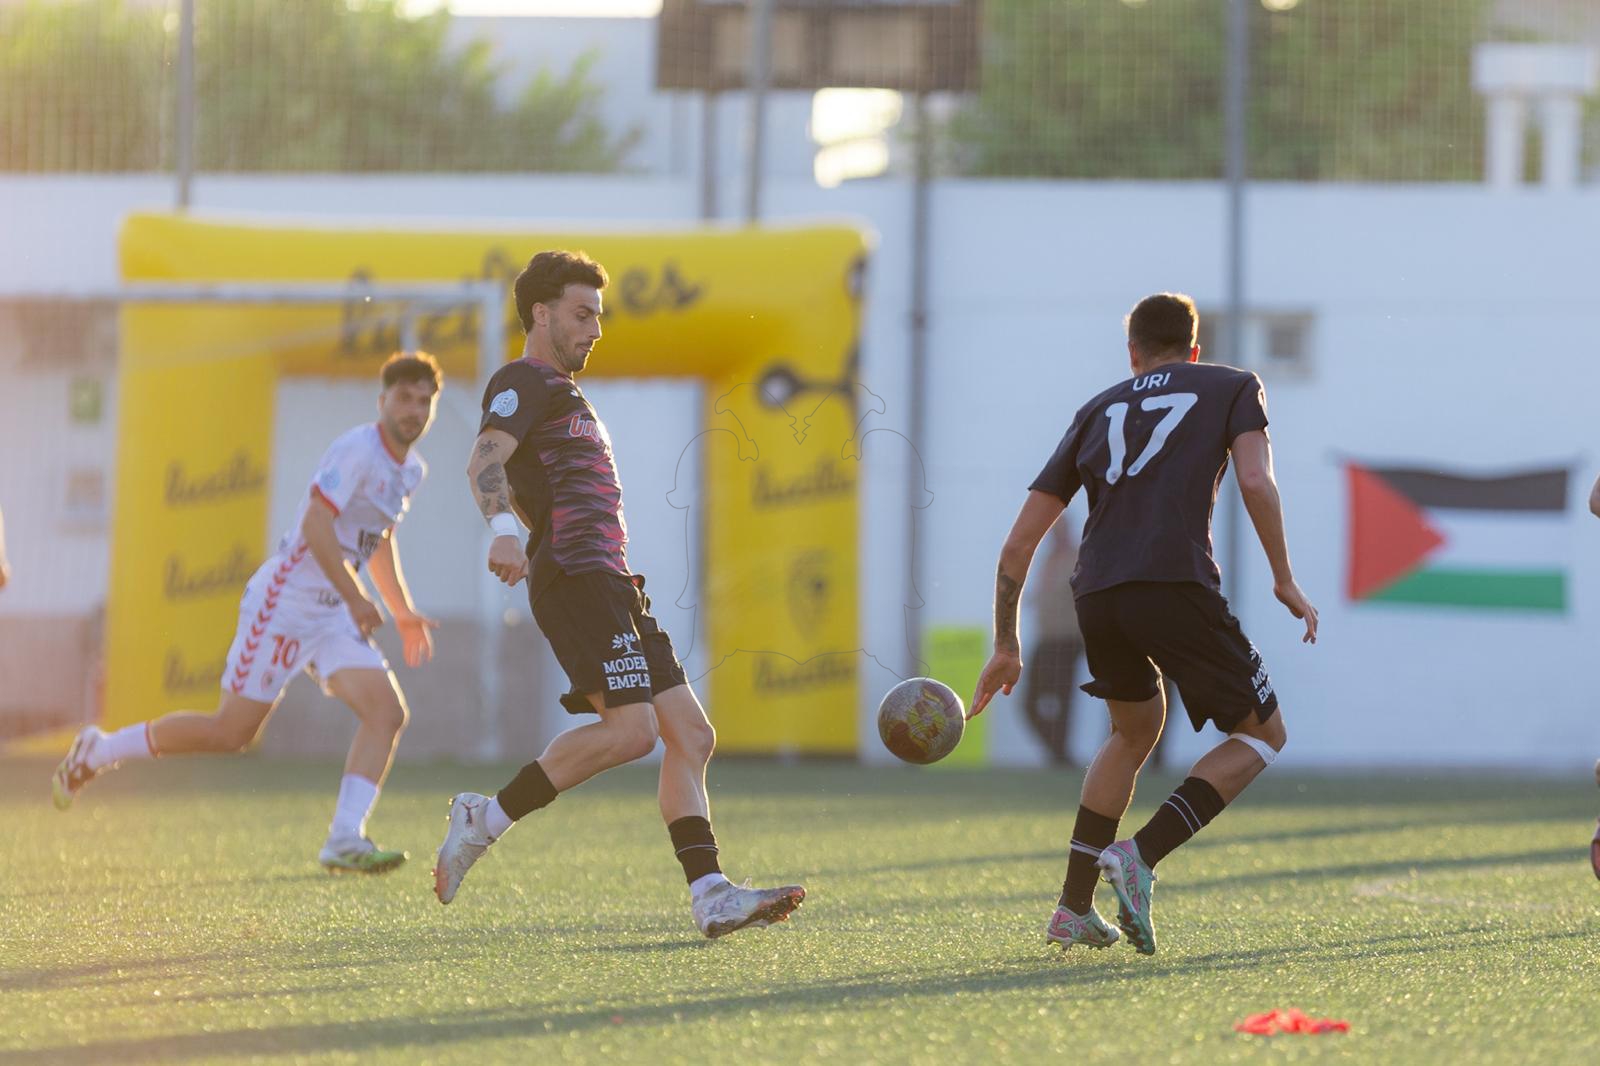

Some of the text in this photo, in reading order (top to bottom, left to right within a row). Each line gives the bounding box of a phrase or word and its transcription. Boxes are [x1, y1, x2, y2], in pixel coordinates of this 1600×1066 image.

[1133, 372, 1171, 391] URI
[1105, 392, 1198, 485] 17
[272, 634, 300, 669] 10
